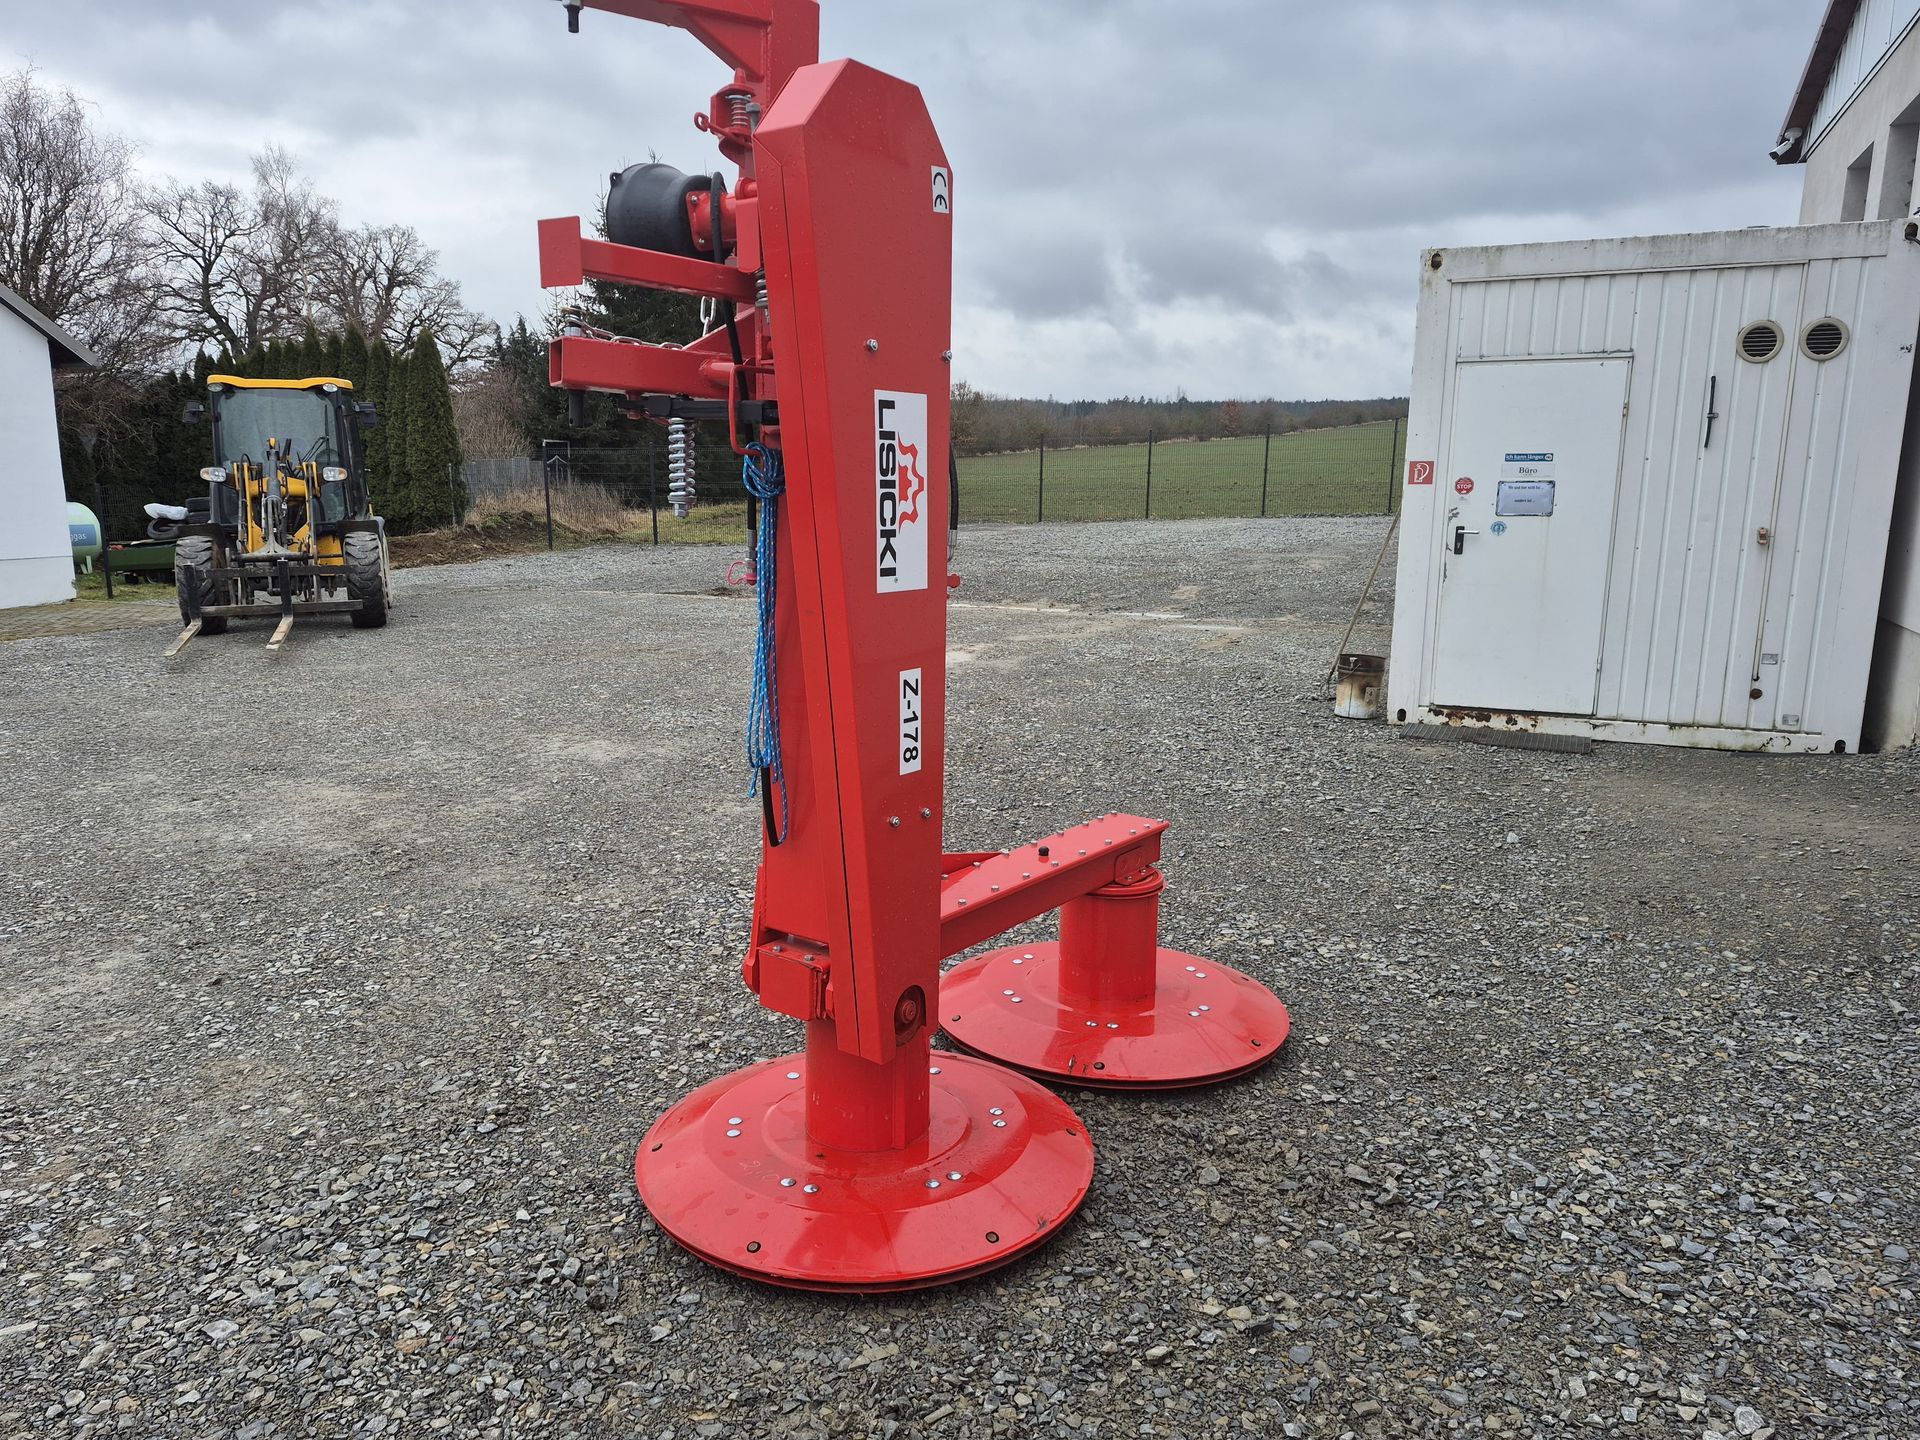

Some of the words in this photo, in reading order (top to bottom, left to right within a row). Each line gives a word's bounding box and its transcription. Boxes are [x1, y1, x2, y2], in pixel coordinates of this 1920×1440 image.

[933, 172, 948, 210] CE
[878, 399, 897, 577] LISICKI
[903, 678, 919, 763] Z-178
